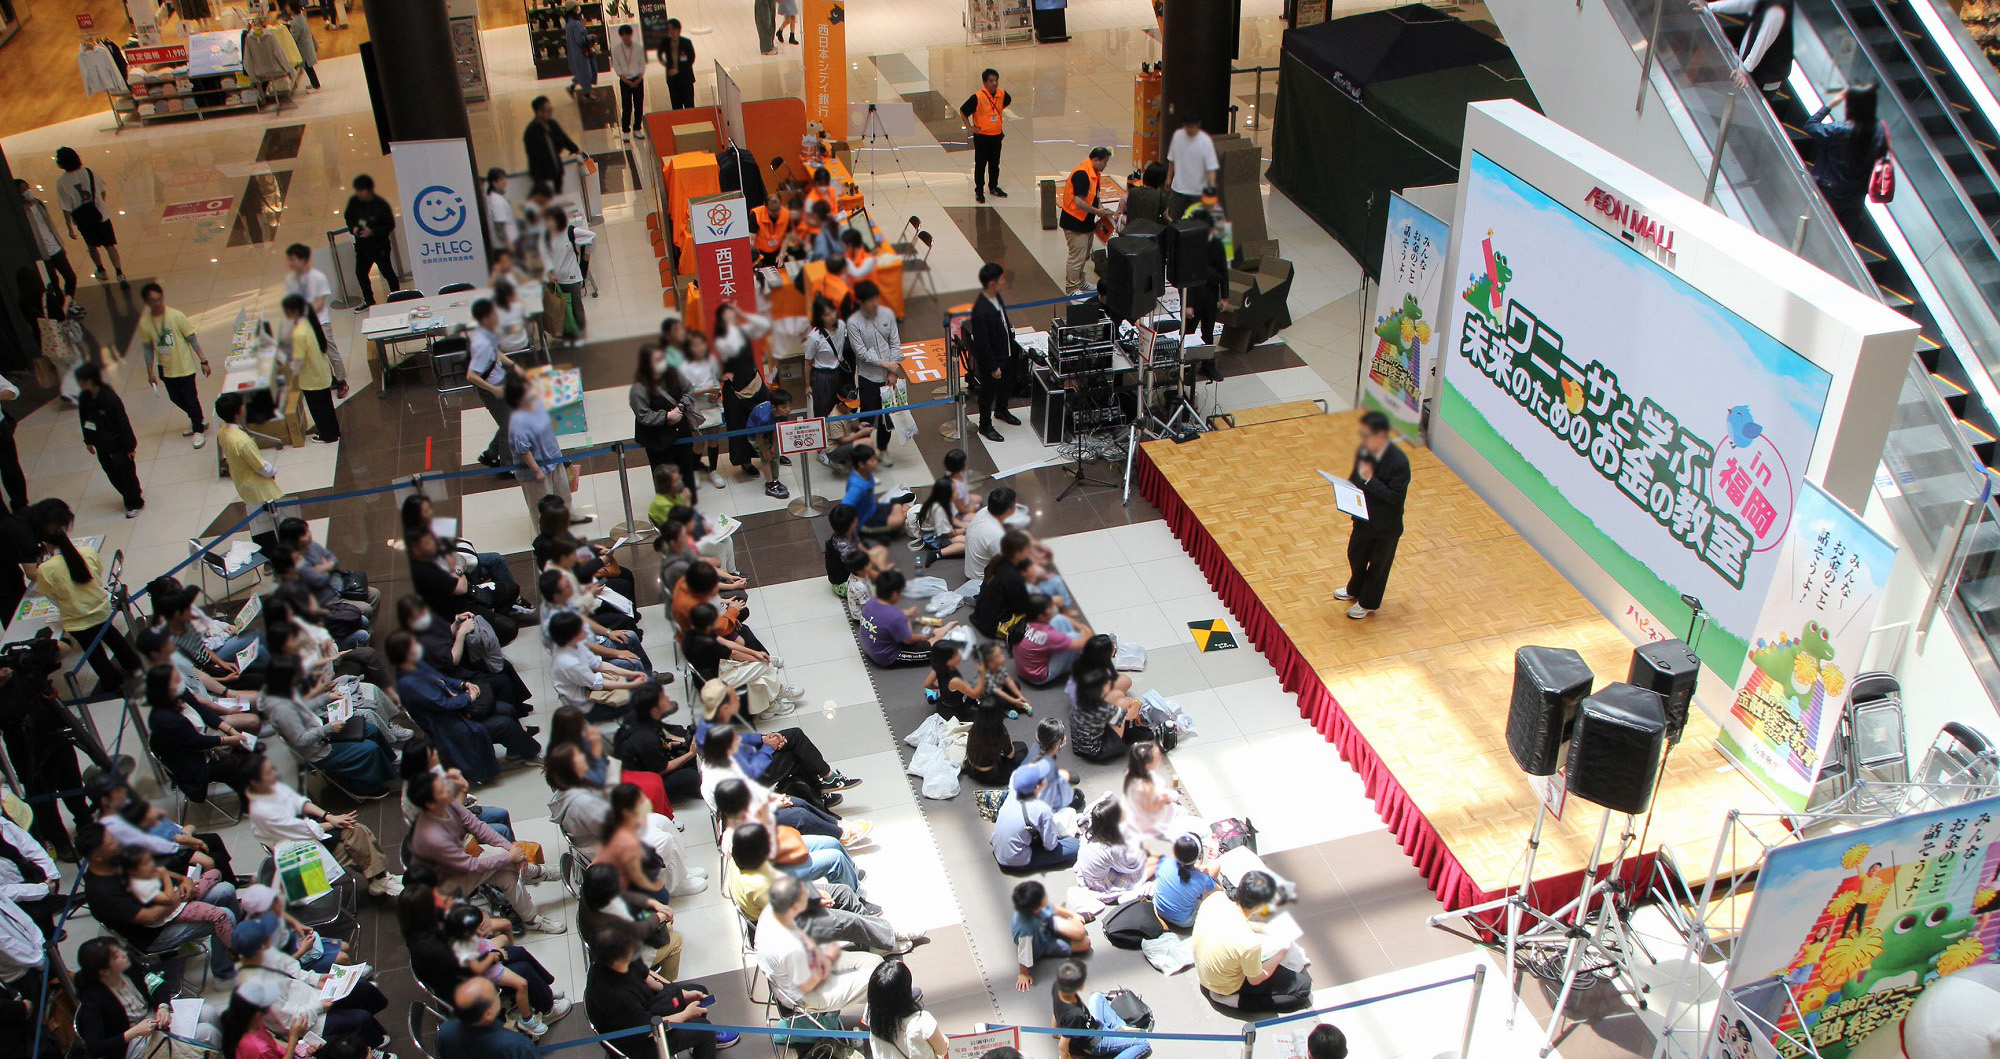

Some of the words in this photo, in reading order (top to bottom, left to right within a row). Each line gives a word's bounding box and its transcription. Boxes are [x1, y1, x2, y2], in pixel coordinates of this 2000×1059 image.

[817, 23, 830, 118] 西日本シティ銀行
[420, 239, 473, 256] J-FLEC
[1408, 230, 1421, 285] お金のこと
[1629, 208, 1677, 256] MALL
[715, 247, 738, 306] 西日本
[1506, 302, 1712, 494] ワニーサと学ぶ
[1461, 316, 1752, 585] 未来のためのお金の教室
[1750, 451, 1772, 488] in
[1719, 457, 1778, 540] 福岡
[1815, 540, 1847, 611] お金のこと
[1928, 818, 1968, 894] お金のこと
